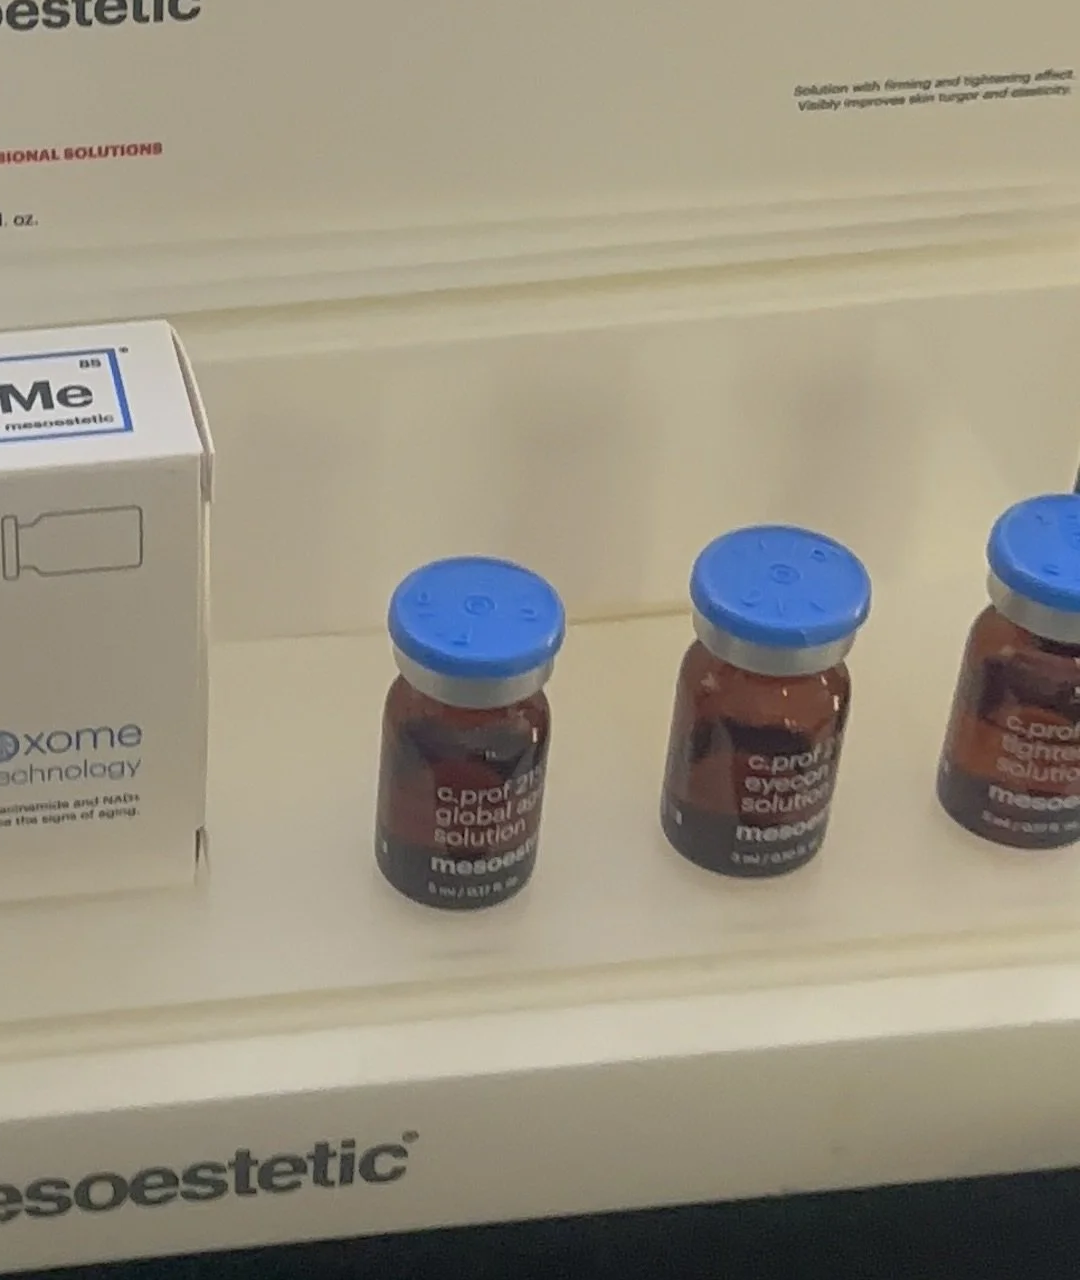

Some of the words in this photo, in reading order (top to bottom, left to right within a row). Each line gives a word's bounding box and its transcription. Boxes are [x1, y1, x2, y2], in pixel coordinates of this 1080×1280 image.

[64, 142, 163, 160] SOLUTIONS
[79, 358, 102, 369] 85
[5, 413, 115, 432] mesoestetic
[748, 746, 820, 776] c.prof
[745, 764, 829, 796] eyecon
[73, 796, 99, 808] and
[436, 779, 511, 808] c.prof
[741, 782, 829, 814] solution
[16, 815, 38, 826] the
[42, 812, 77, 825] signs
[80, 809, 94, 819] of
[434, 802, 512, 827] global
[433, 818, 527, 849] solution
